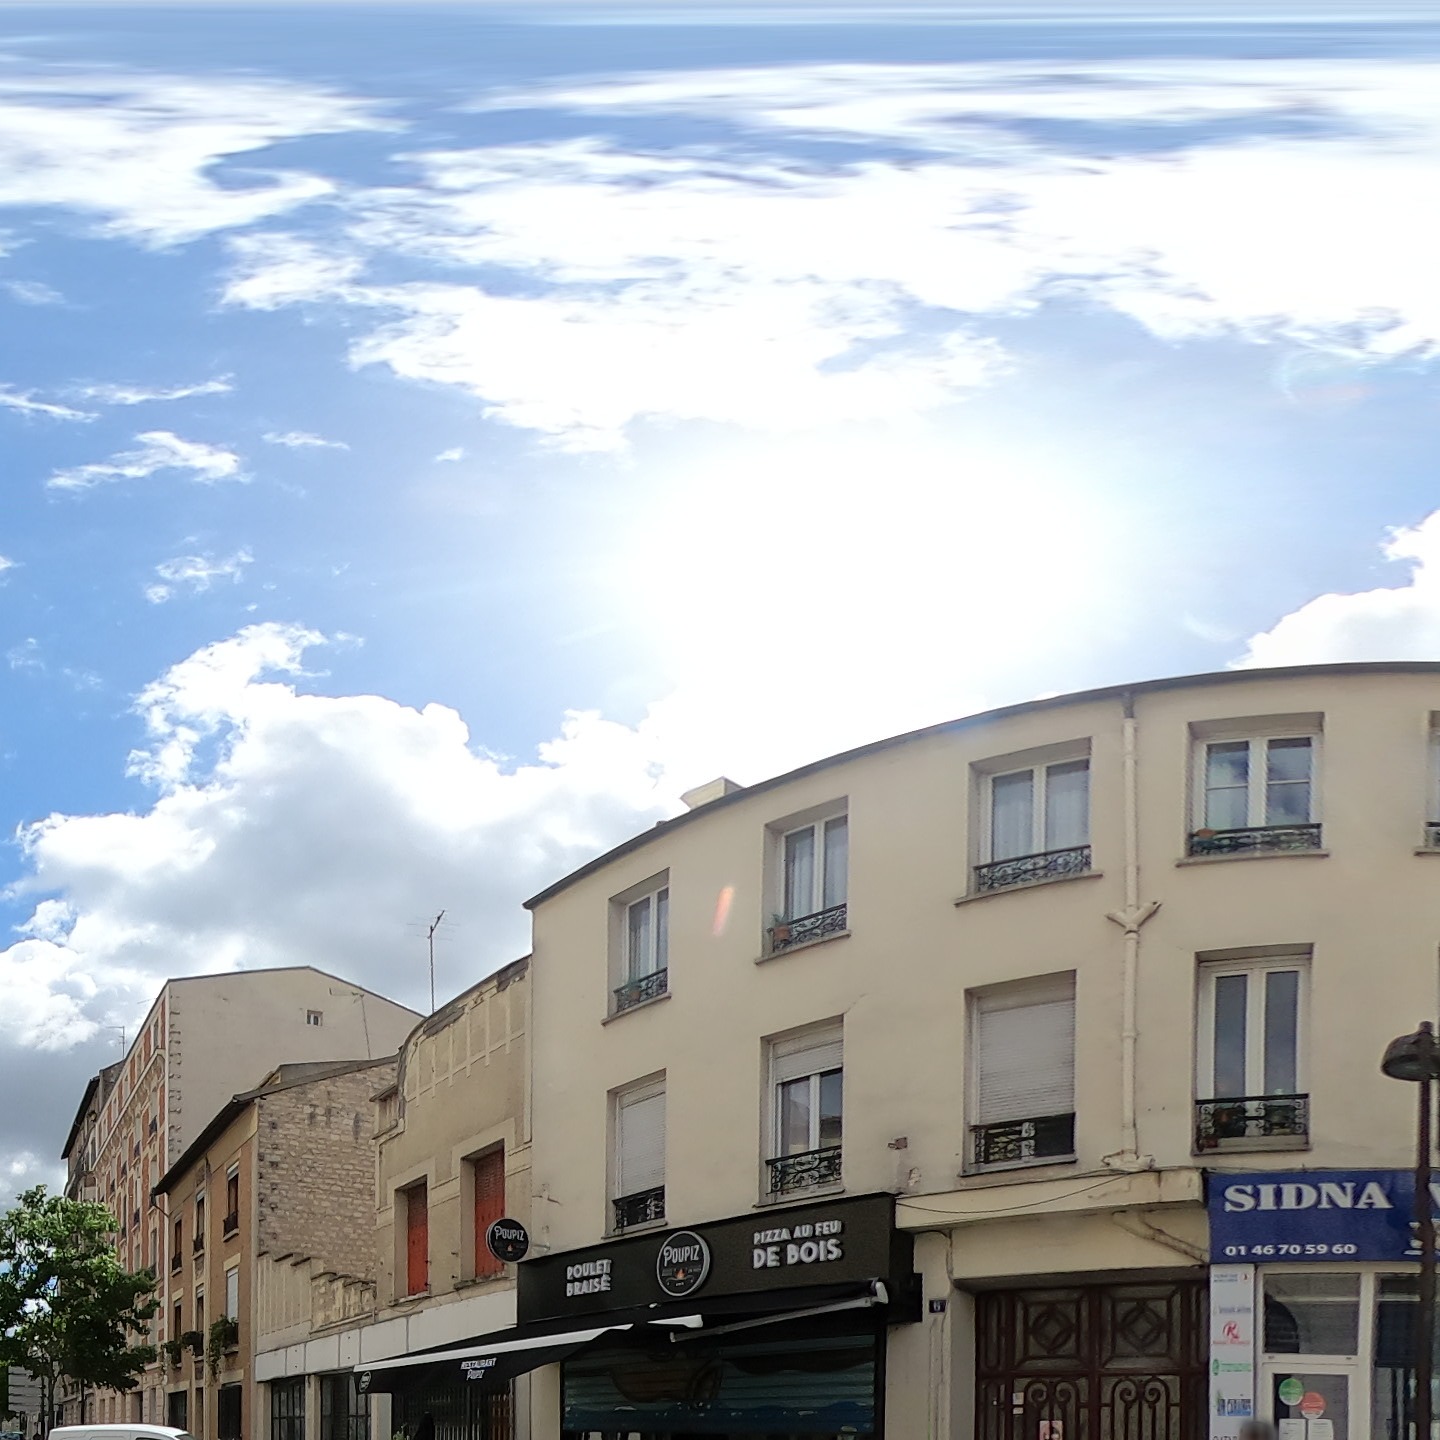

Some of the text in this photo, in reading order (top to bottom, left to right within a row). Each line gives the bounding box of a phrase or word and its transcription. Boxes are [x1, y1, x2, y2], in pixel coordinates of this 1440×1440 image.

[1223, 1182, 1394, 1212] SIDNA
[494, 1225, 525, 1241] POUPIZ
[753, 1220, 842, 1245] PIZZA AU FEU
[663, 1244, 700, 1267] POUPIZ
[752, 1238, 843, 1269] DE BOIS
[1225, 1243, 1358, 1256] 01 46 70 59 60
[566, 1258, 612, 1280] POULET
[566, 1274, 612, 1297] BRAISÉ
